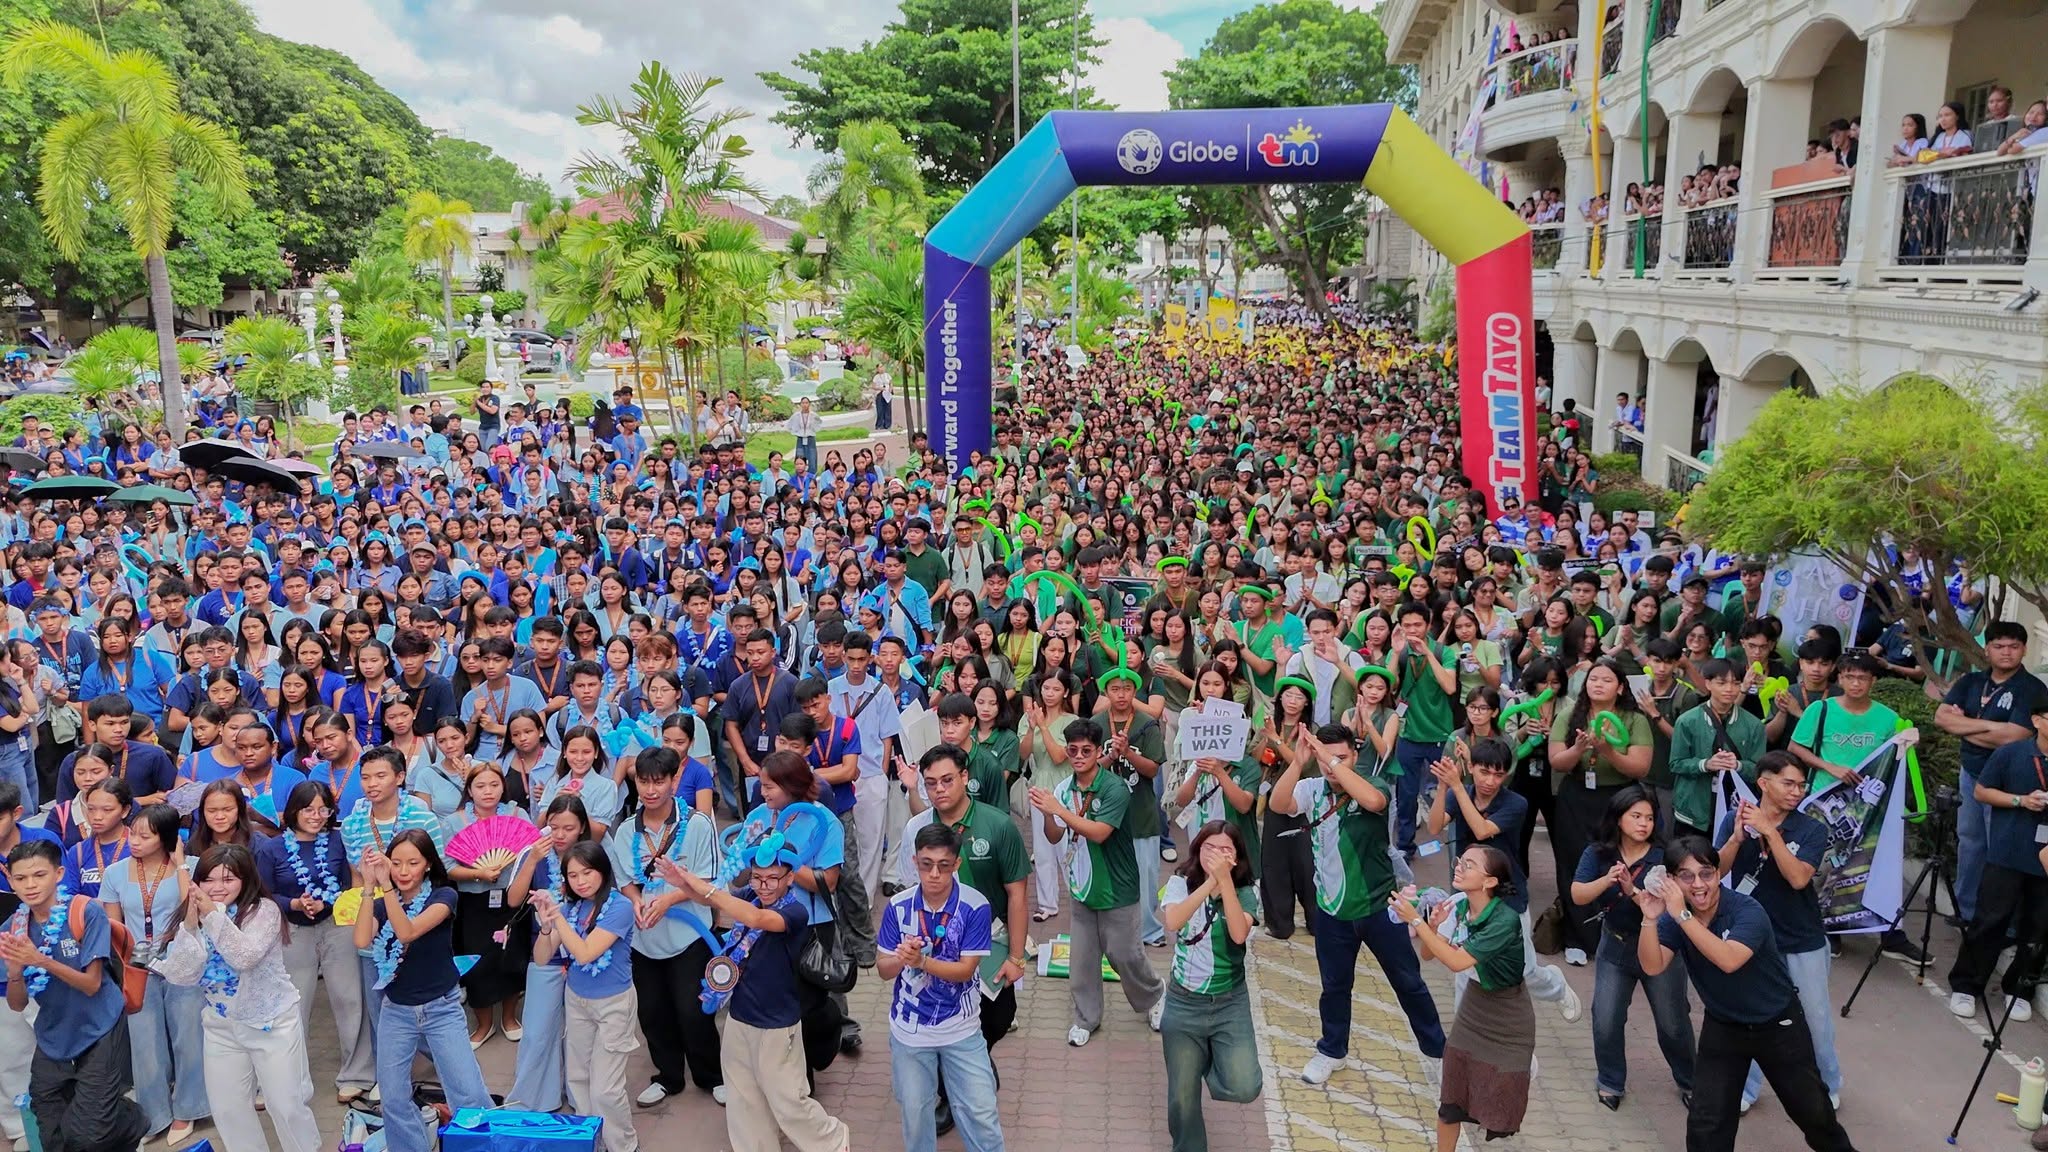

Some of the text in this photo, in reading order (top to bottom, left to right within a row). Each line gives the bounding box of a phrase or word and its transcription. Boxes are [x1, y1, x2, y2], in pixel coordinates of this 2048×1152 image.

[1168, 140, 1239, 163] Globe
[1258, 133, 1320, 167] tm
[940, 298, 962, 396] Together
[1191, 724, 1233, 738] THIS
[1191, 738, 1230, 751] WAY
